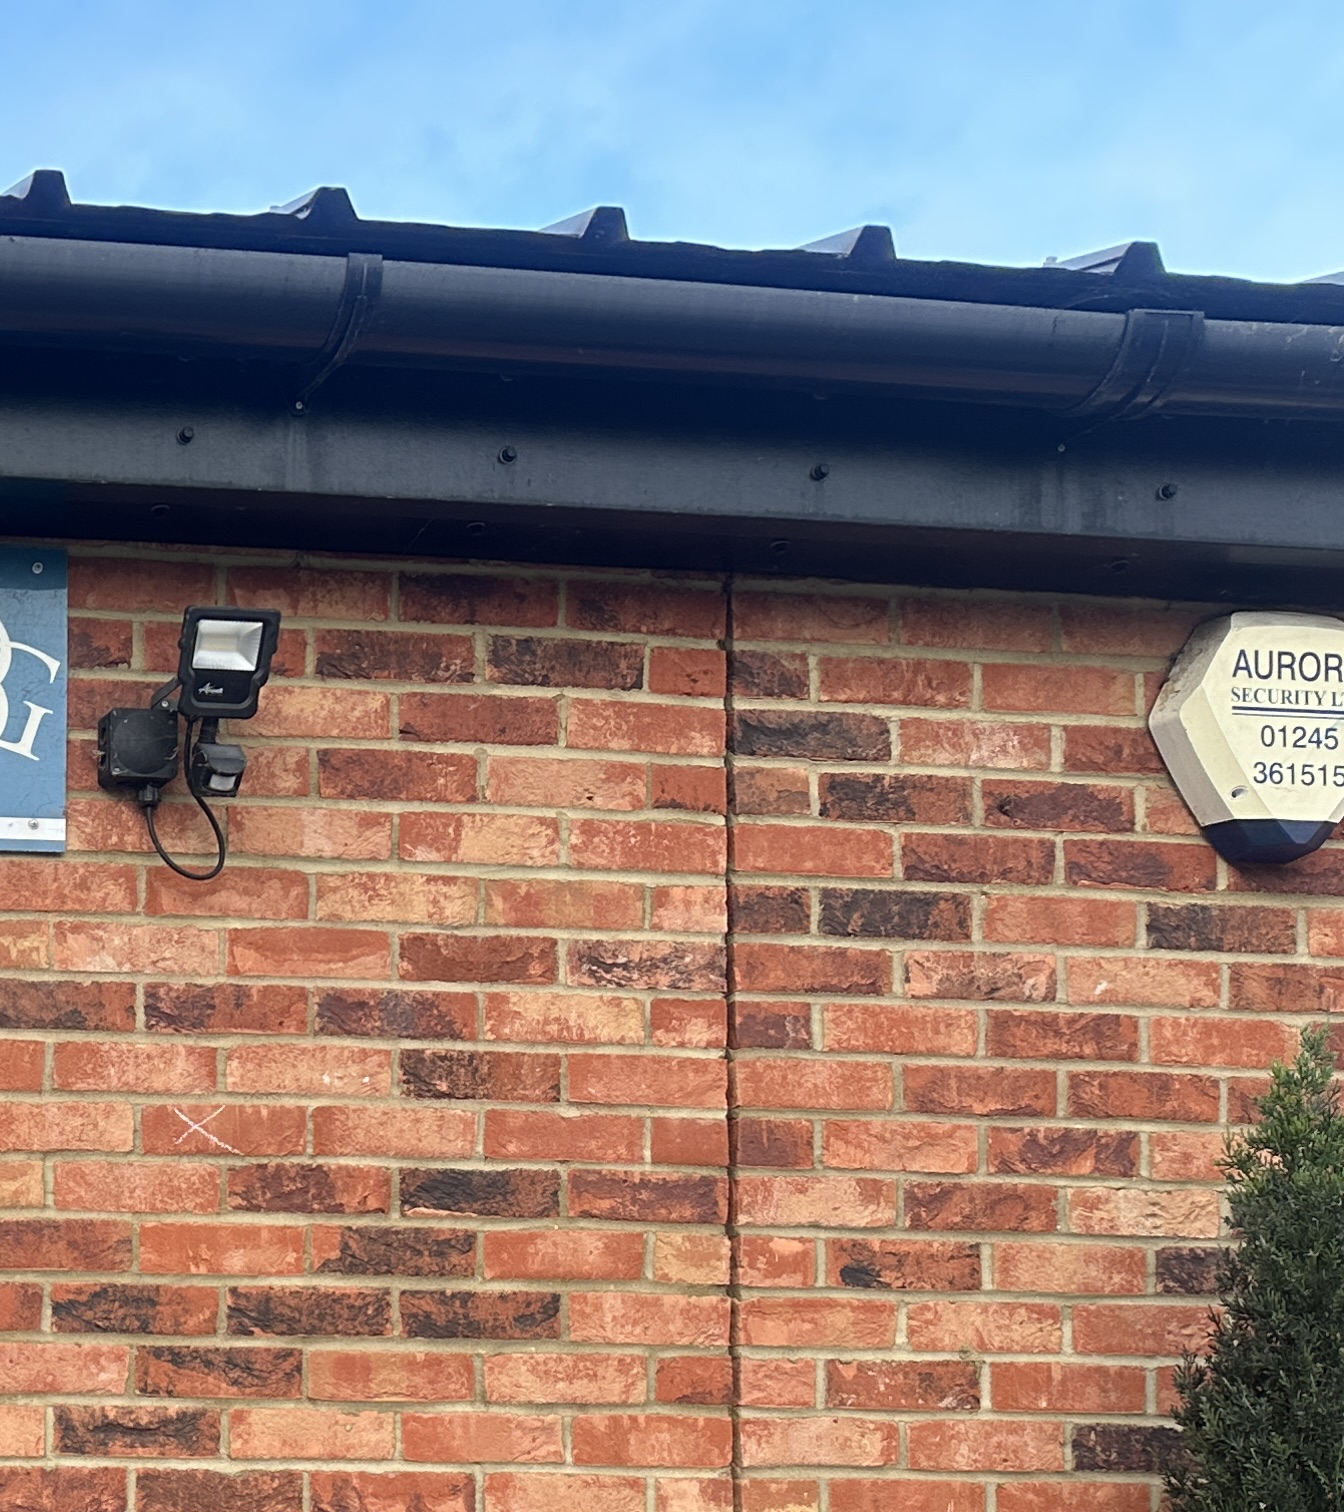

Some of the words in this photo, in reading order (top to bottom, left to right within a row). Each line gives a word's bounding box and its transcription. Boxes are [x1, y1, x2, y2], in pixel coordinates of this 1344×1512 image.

[1232, 649, 1344, 683] AUROR
[1231, 686, 1327, 707] SECURITY
[1260, 724, 1339, 750] 01245
[1253, 761, 1344, 787] 361515
